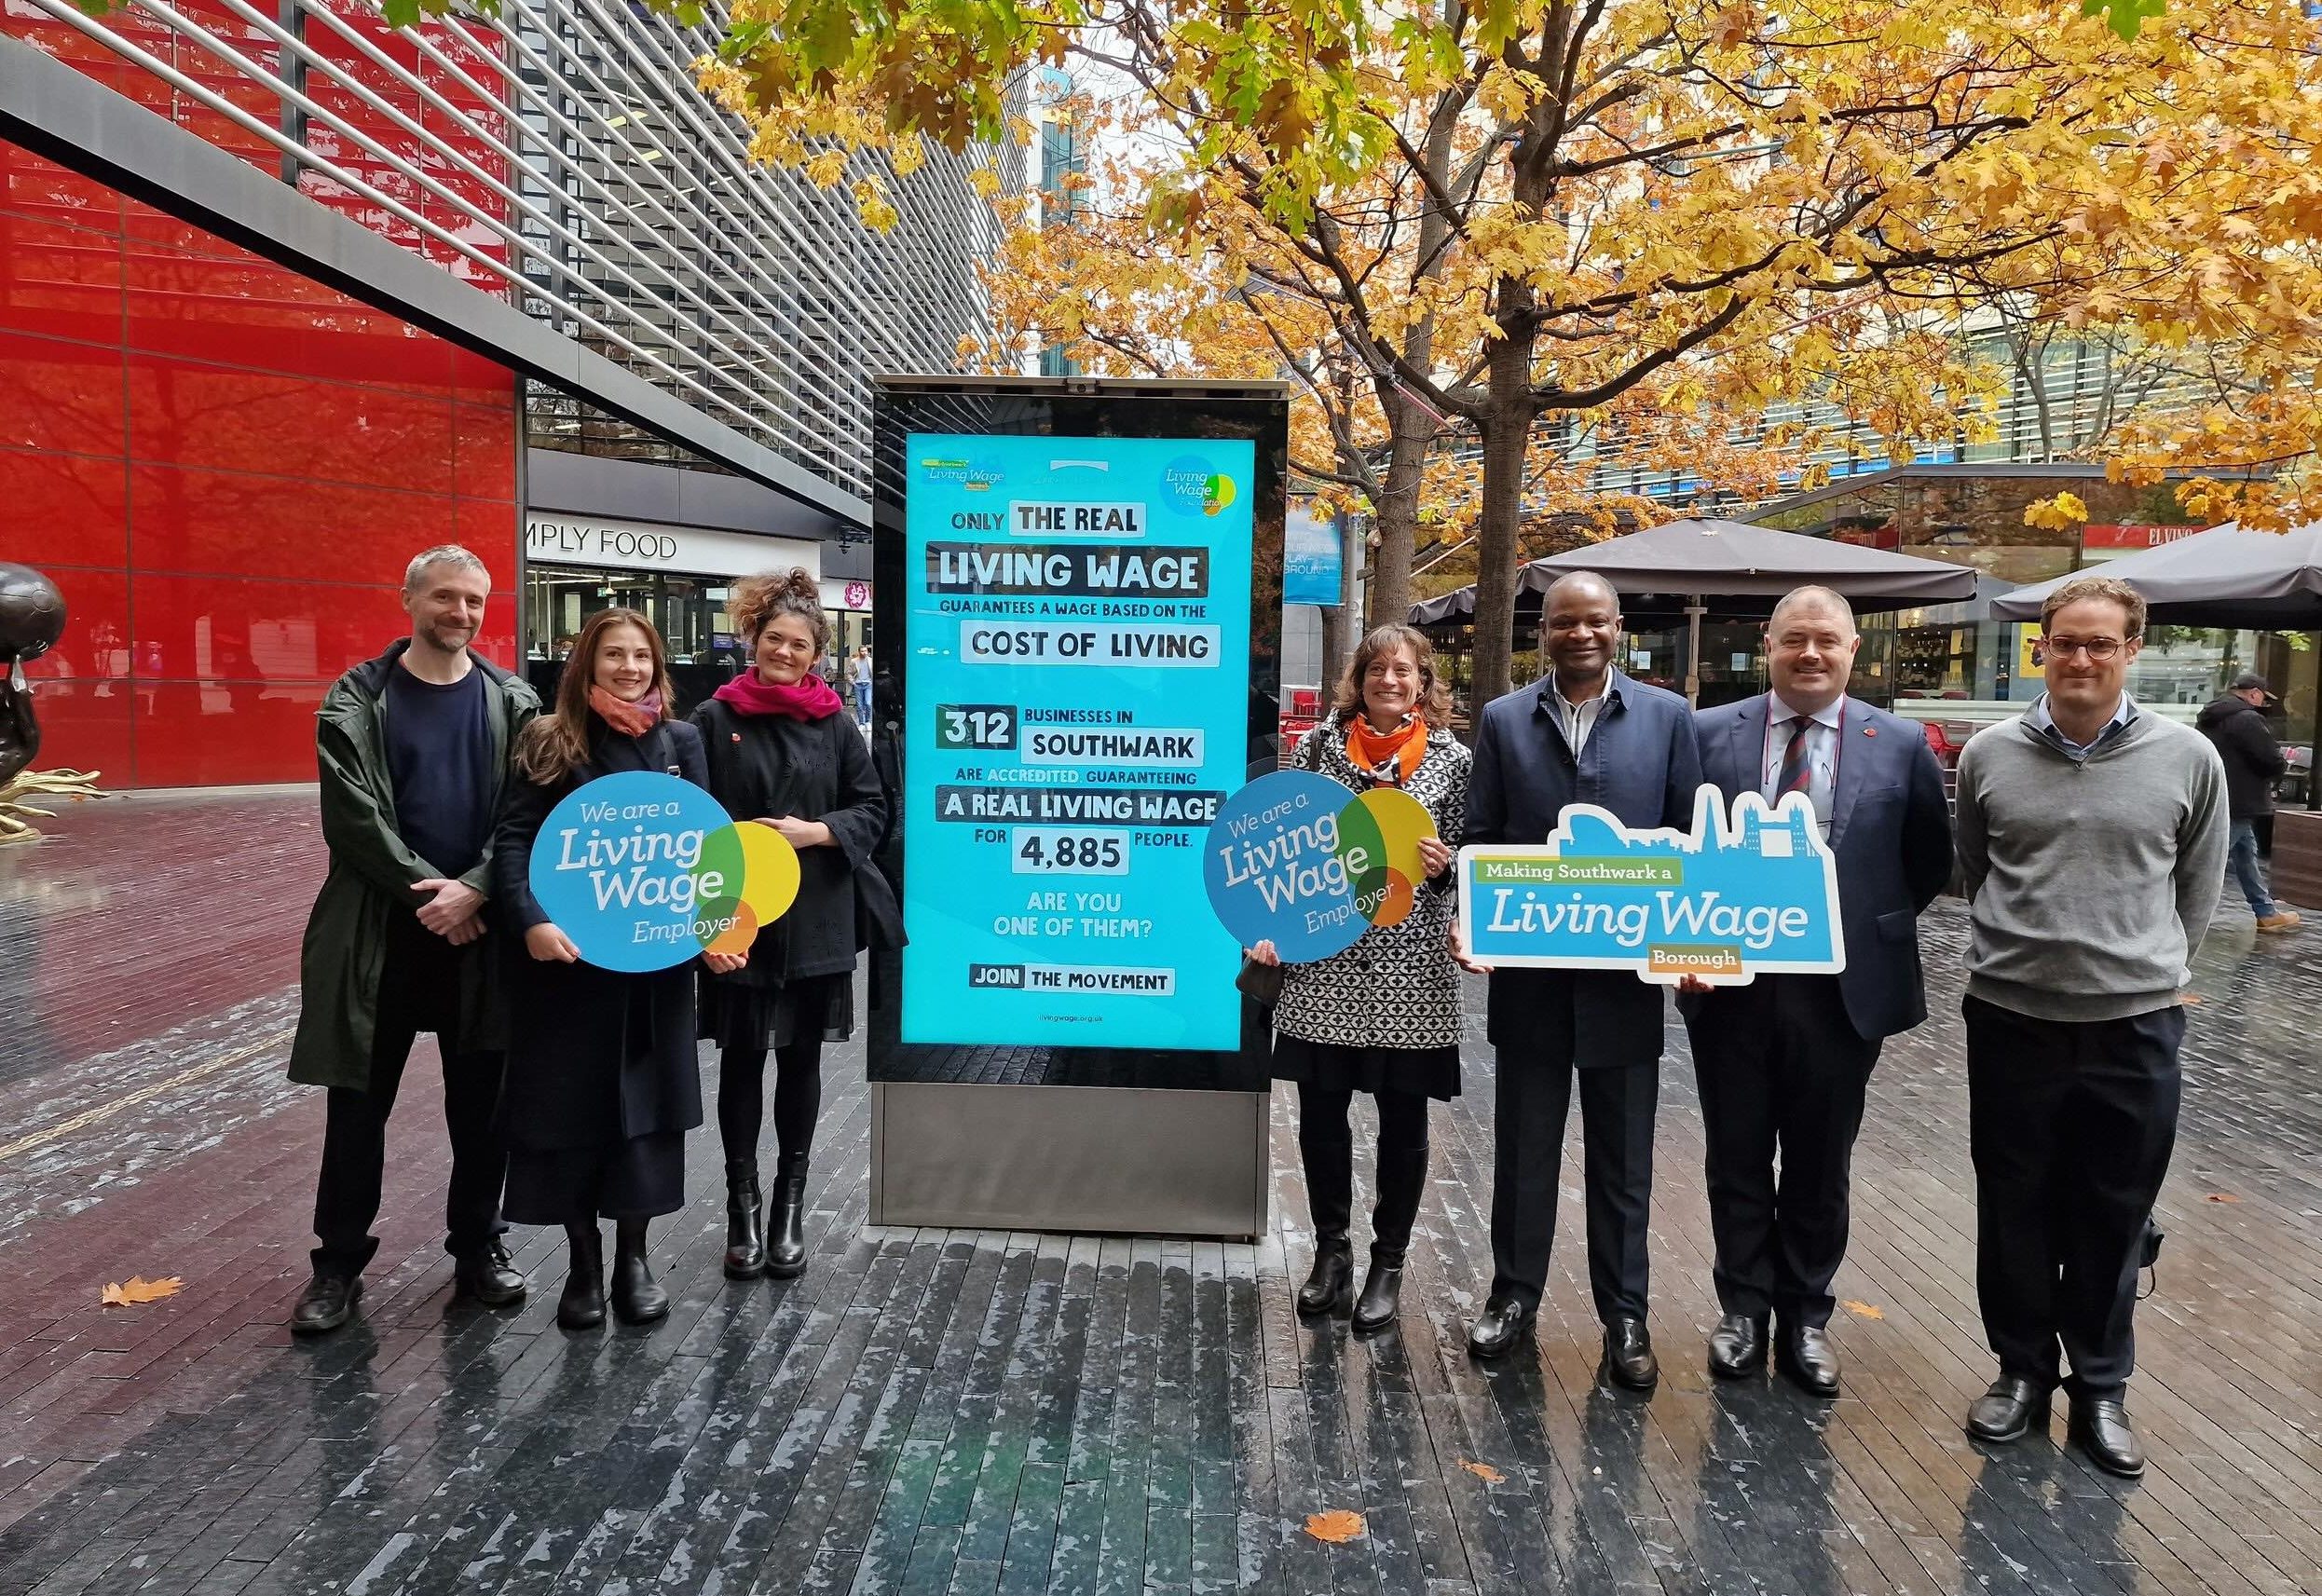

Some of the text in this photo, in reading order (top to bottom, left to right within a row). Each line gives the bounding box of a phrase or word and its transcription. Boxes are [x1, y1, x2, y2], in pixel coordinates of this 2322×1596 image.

[1167, 469, 1208, 485] Living
[1174, 483, 1212, 498] Wage
[951, 507, 1138, 532] ONLY THE REAL
[600, 530, 677, 558] FOOD
[939, 552, 1198, 589] LIVING WAGE
[940, 600, 1207, 618] GUARANTEES A WAGE BASED ON THE
[972, 630, 1209, 659] COST OF LIVING
[945, 712, 1009, 743] 312
[1024, 708, 1133, 724] BUSINESSES IN
[1032, 734, 1195, 758] SOUTHWARK
[955, 768, 983, 781] ARE
[1086, 771, 1197, 784] GUARANTEEING
[580, 801, 681, 824] We are a
[944, 793, 1217, 820] A REAL LIVING WAGE
[1227, 793, 1310, 839] We are a
[554, 825, 704, 871] Living
[975, 829, 1194, 869] FOR 4,885 PEOPLE.
[1219, 812, 1340, 888] Living
[1253, 846, 1370, 914] Wage
[1486, 863, 1673, 881] Making Southwark a
[588, 866, 724, 913] Wage
[1027, 893, 1121, 912] ARE YOU
[1304, 881, 1395, 934] Employer
[1486, 888, 1810, 949] Living Wage
[632, 914, 742, 944] Employer
[993, 917, 1153, 938] ONE OF THEM?
[1652, 949, 1737, 971] Borough
[975, 968, 1168, 990] JOIN THE MOVEMENT
